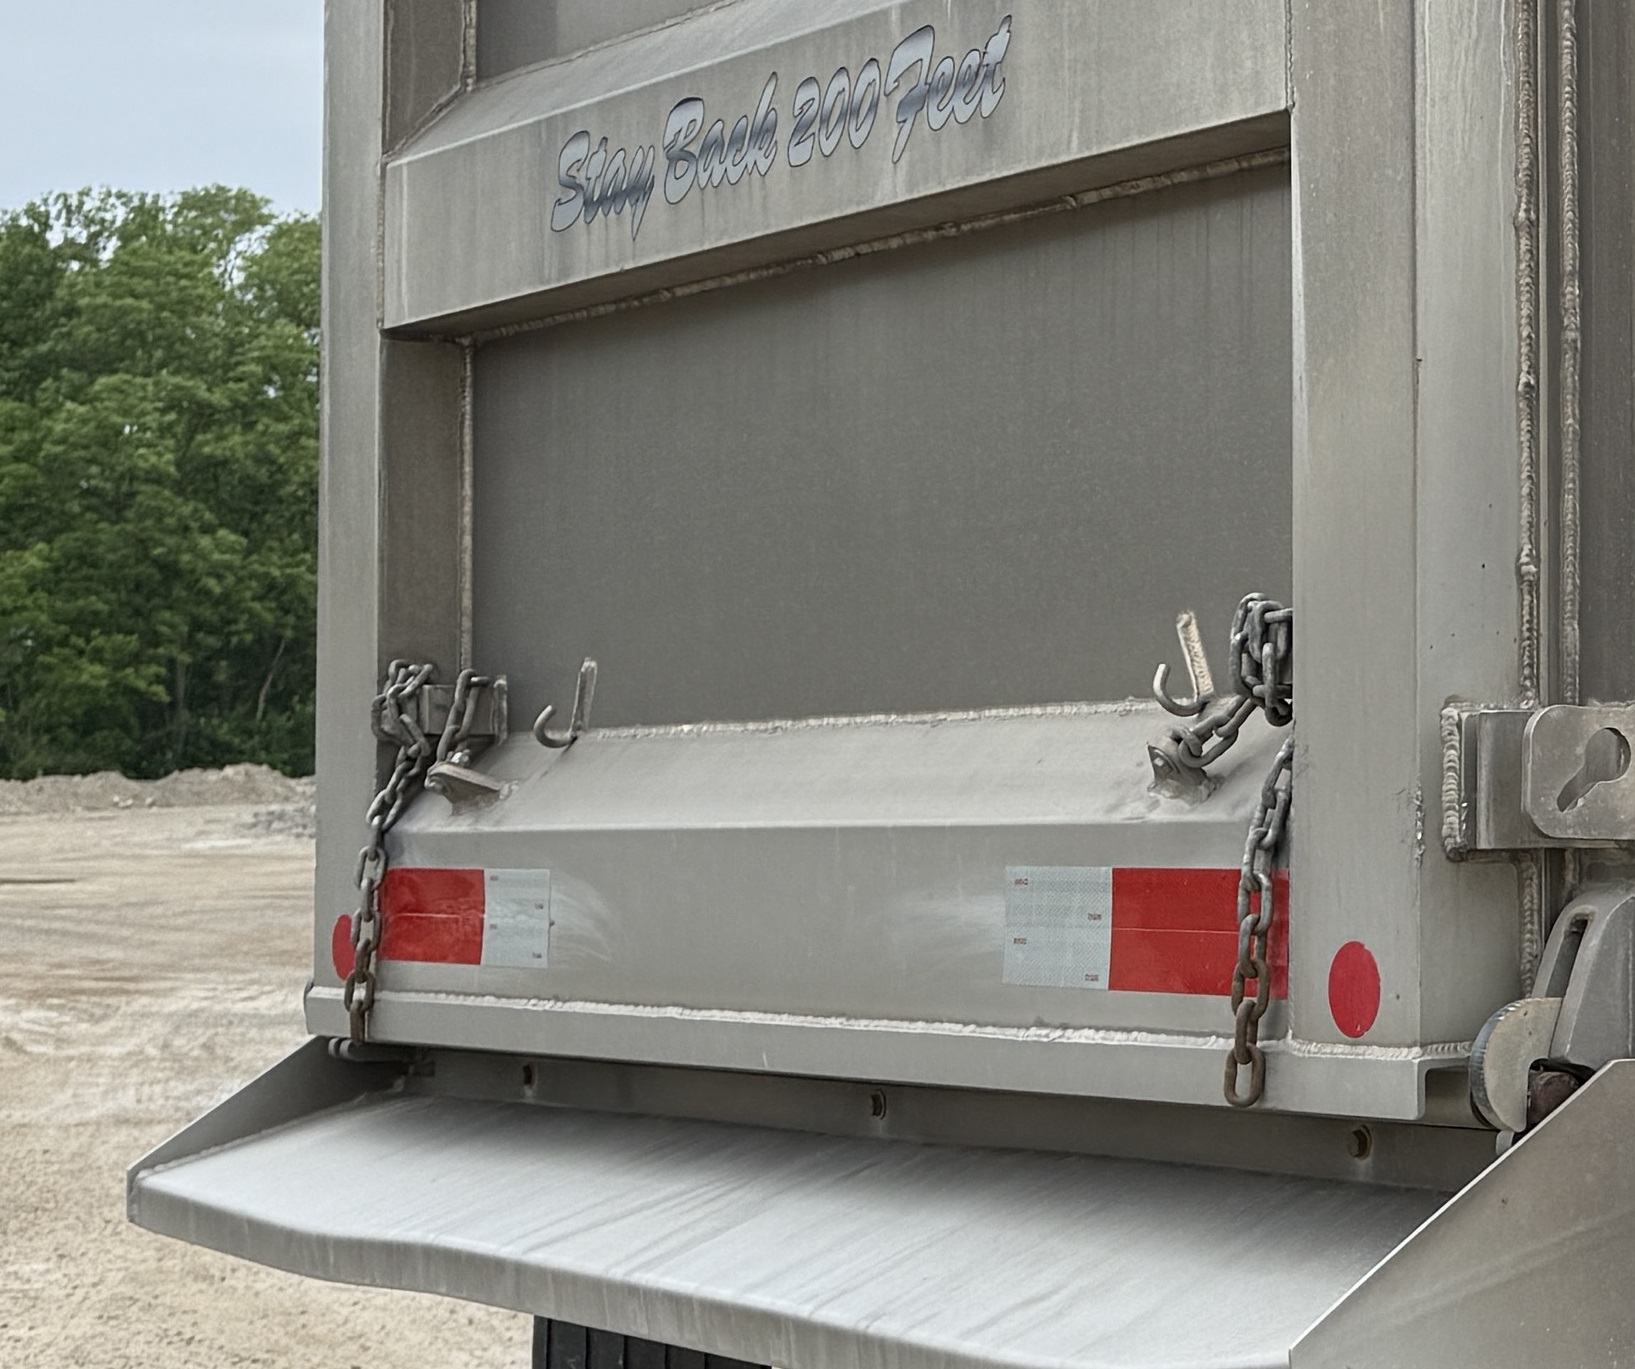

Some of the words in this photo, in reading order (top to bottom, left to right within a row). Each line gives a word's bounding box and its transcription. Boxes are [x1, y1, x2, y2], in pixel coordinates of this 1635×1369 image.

[551, 131, 655, 240] Stay
[663, 72, 778, 204] Back
[787, 57, 880, 167] 200
[885, 15, 1012, 164] Feet
